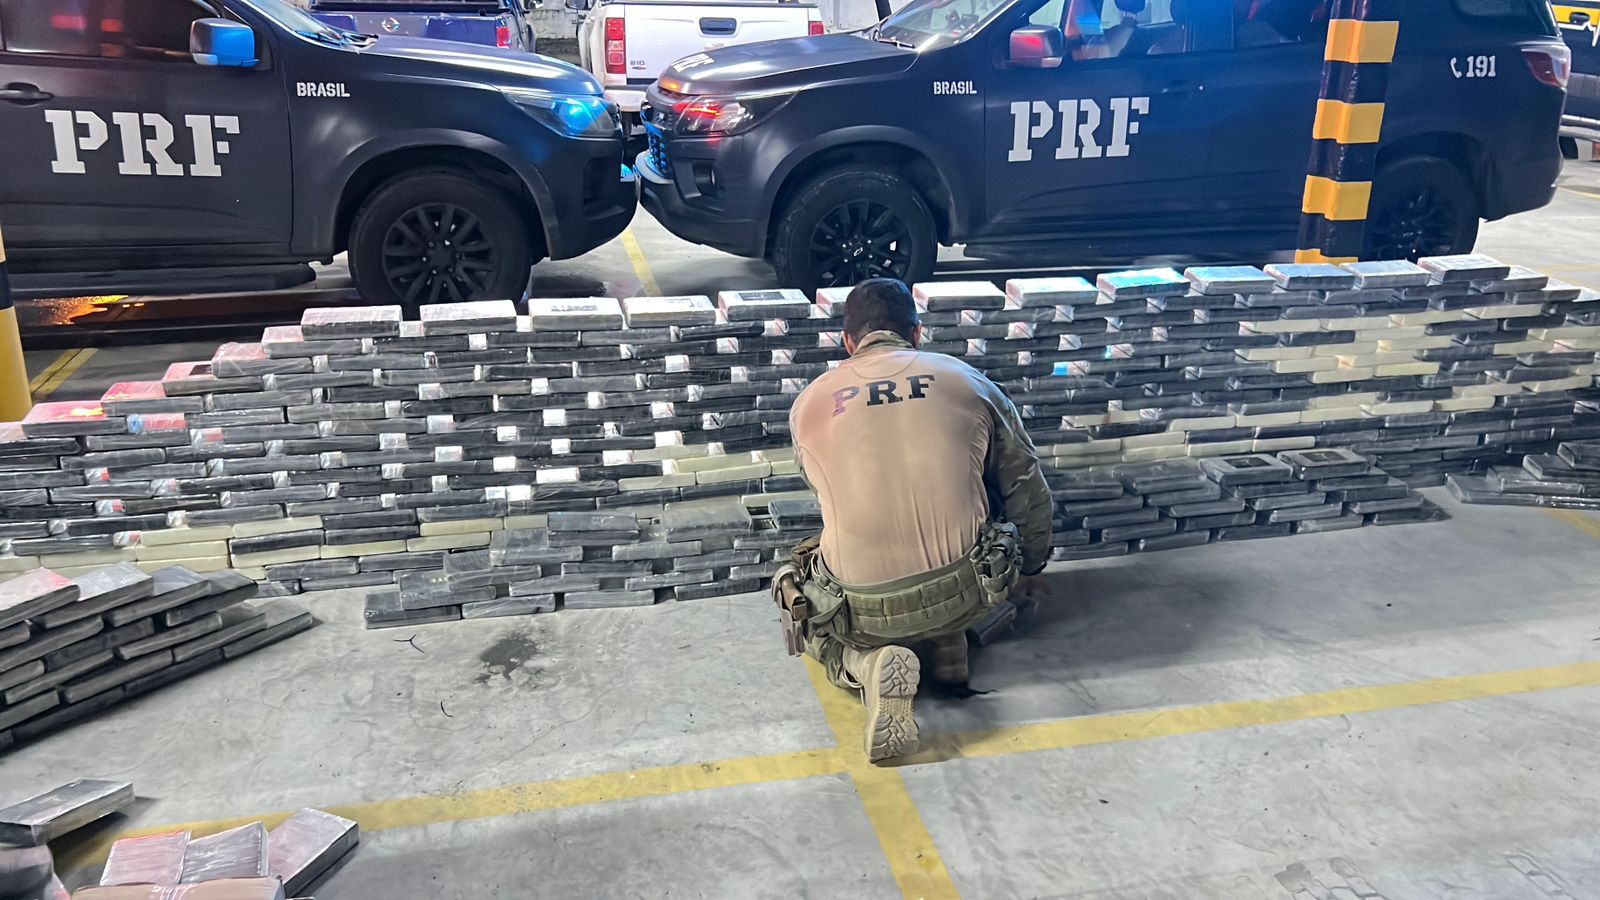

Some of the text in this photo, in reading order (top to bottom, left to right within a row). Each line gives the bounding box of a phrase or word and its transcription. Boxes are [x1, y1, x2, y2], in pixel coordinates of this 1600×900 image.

[1466, 55, 1496, 77] 191
[296, 82, 351, 98] BRASIL
[933, 81, 978, 95] BRASIL
[45, 110, 240, 177] PRF
[1008, 97, 1150, 162] PRF
[832, 374, 936, 417] PRF
